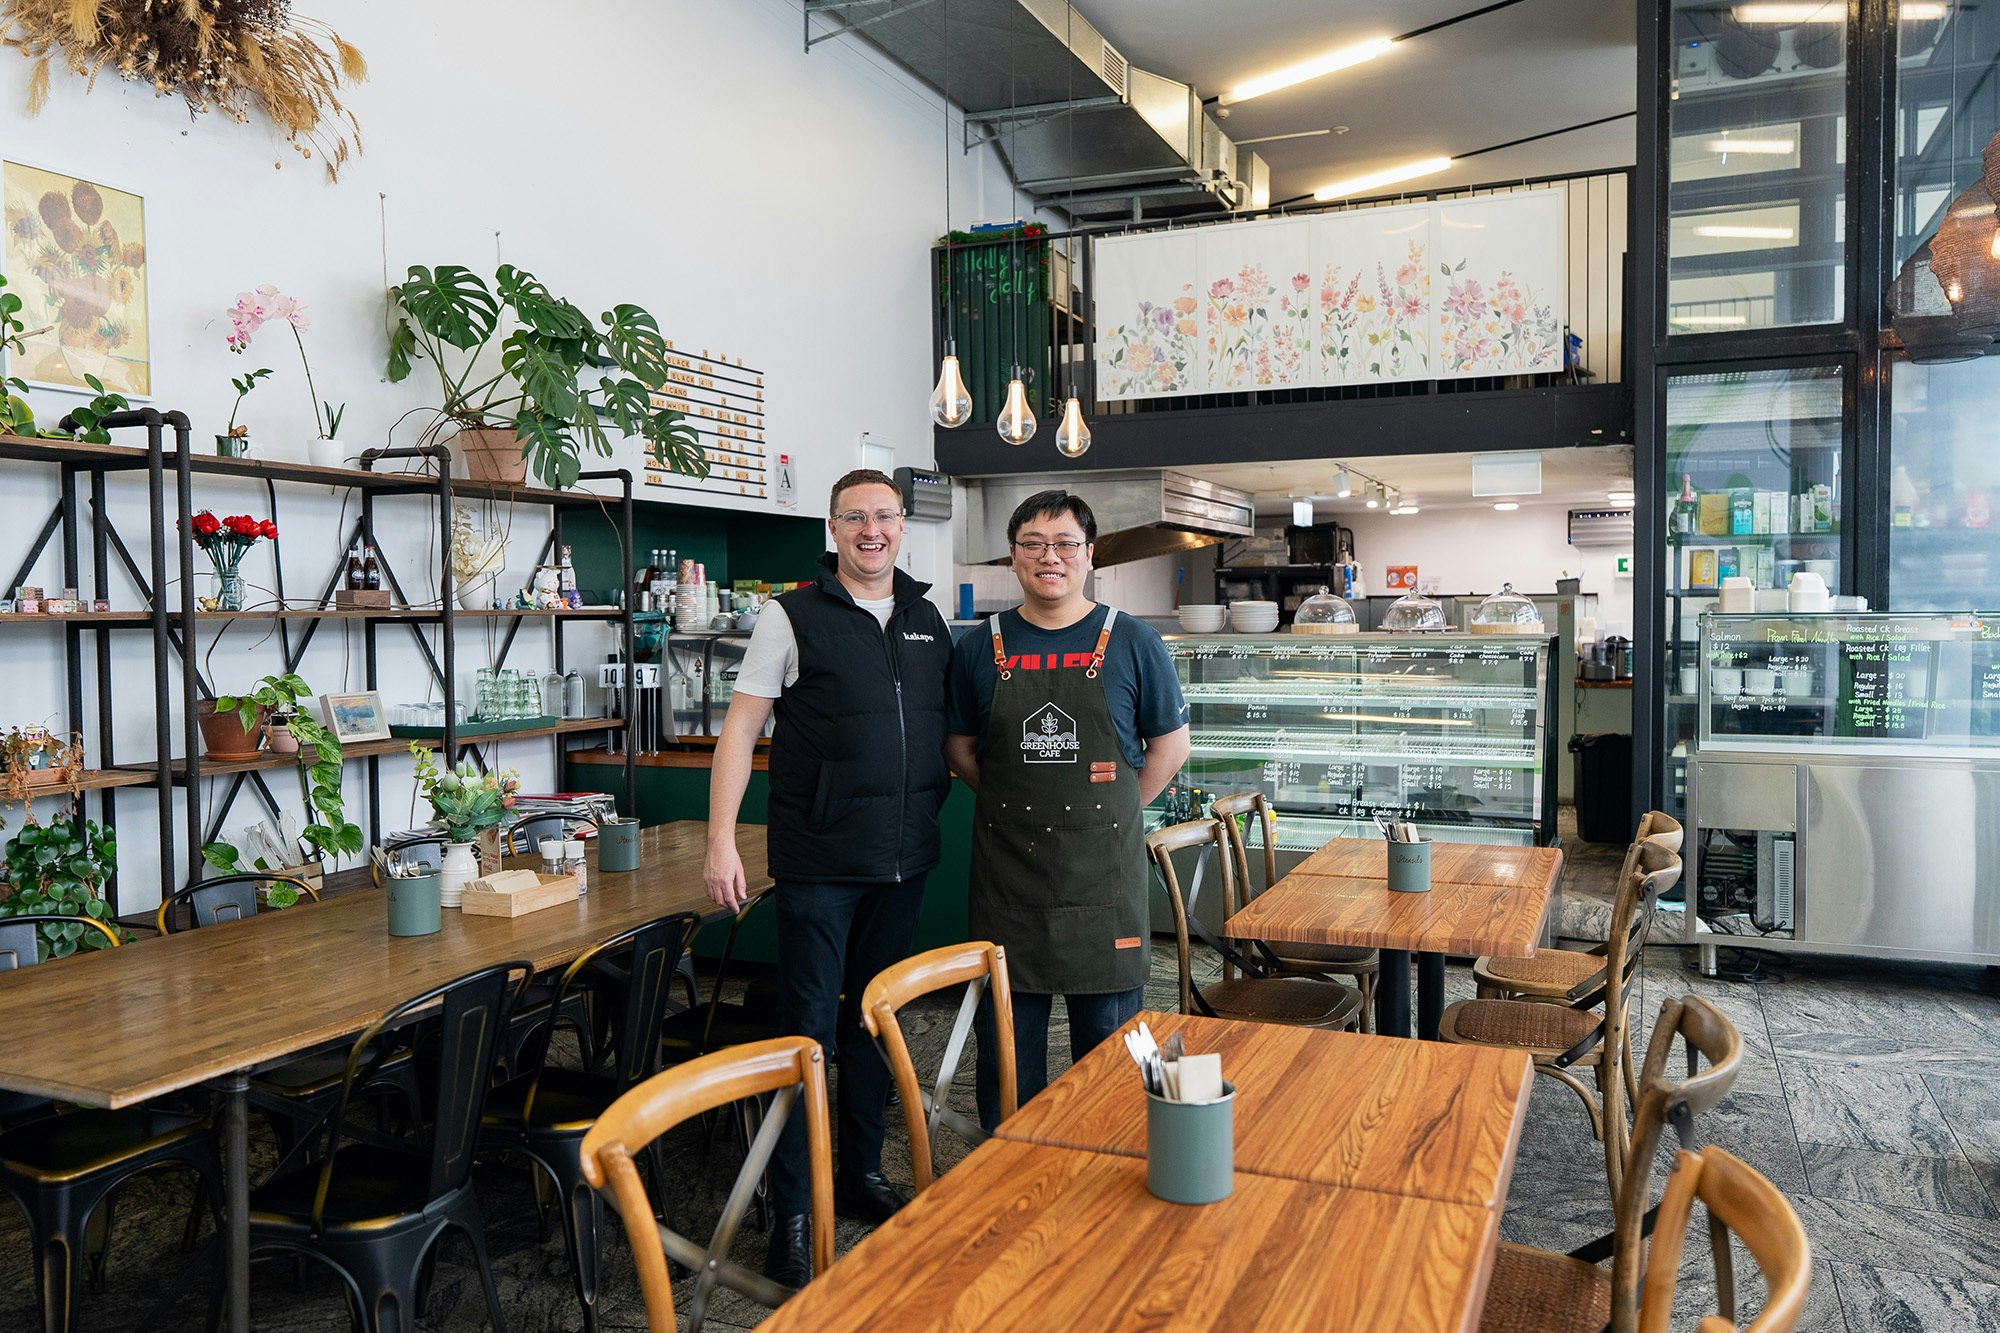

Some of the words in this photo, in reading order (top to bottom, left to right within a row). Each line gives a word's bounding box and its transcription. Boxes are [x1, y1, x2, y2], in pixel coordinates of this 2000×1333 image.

[667, 357, 689, 368] BLACK
[672, 373, 695, 384] BLACK
[647, 474, 662, 483] TEA
[781, 468, 791, 488] A
[1846, 624, 1877, 633] Roasted
[1894, 625, 1920, 634] Breast
[903, 632, 934, 642] kakapo
[1710, 632, 1741, 641] Salmon
[1712, 643, 1730, 651] $12
[1845, 644, 1876, 653] Roasted
[1894, 644, 1907, 654] Leg
[1910, 643, 1931, 653] Fillet
[1769, 656, 1788, 665] Large
[1887, 653, 1911, 662] Salad
[604, 668, 617, 684] 10
[635, 668, 643, 685] 9
[650, 668, 657, 683] 7
[1856, 672, 1877, 681] Large
[1854, 682, 1877, 692] Regular
[1722, 695, 1736, 703] Beef
[1854, 706, 1873, 714] Large
[1020, 741, 1080, 750] GREENHOUSE
[1039, 750, 1061, 758] CAFE
[1328, 763, 1345, 772] Large
[1402, 766, 1420, 774] Large
[1429, 766, 1443, 774] $19
[1473, 768, 1491, 776] Large
[1402, 780, 1419, 788] Small
[1352, 799, 1376, 808] Breast
[1380, 801, 1401, 809] Combo
[1353, 807, 1365, 816] Leg
[1371, 808, 1392, 816] Combo
[1395, 854, 1423, 864] Utensils
